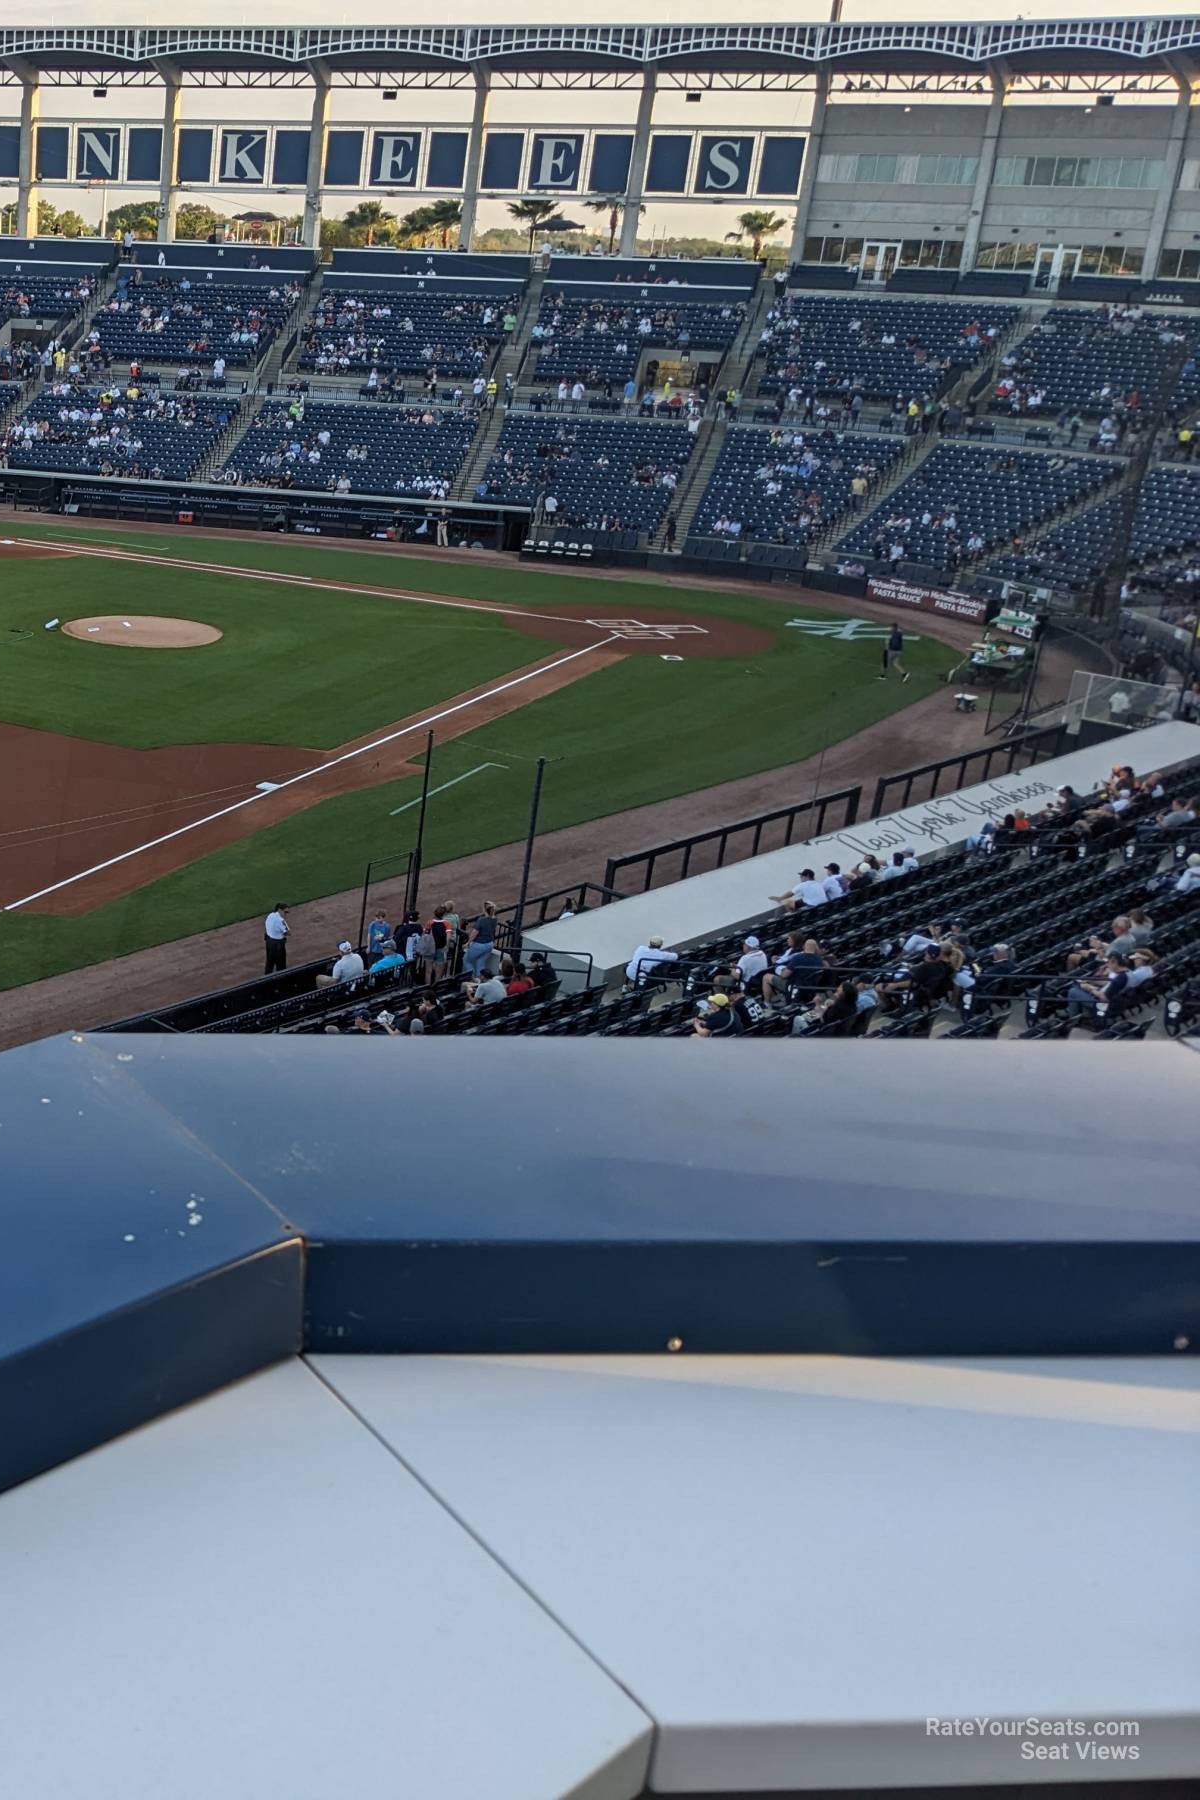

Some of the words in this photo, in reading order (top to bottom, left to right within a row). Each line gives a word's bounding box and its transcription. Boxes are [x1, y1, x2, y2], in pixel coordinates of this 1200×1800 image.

[873, 588, 896, 598] PASTA
[897, 592, 921, 603] SAUCE
[934, 600, 956, 611] PASTA
[957, 606, 979, 617] SAUCE
[815, 830, 906, 855] New
[875, 801, 965, 844] York
[937, 779, 1054, 822] Yankees
[748, 1003, 764, 1022] 99
